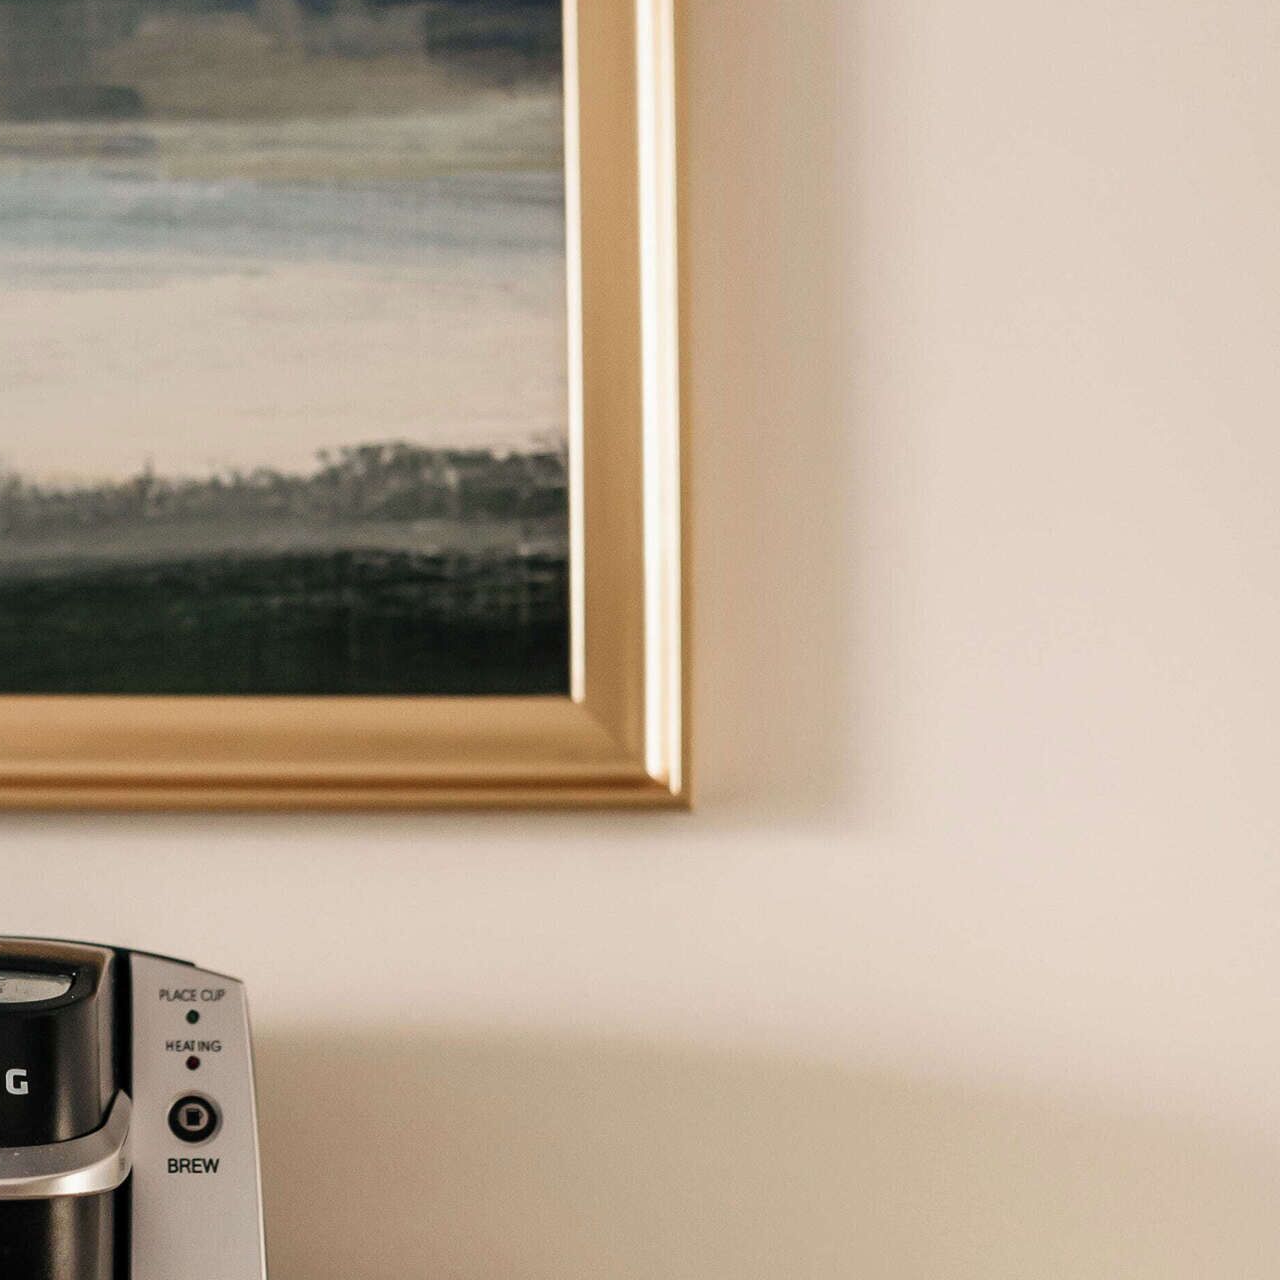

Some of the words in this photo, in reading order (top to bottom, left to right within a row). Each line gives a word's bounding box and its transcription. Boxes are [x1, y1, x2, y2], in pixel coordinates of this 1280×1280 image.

[159, 989, 197, 1001] PLACE
[201, 989, 225, 1001] CUP
[165, 1040, 222, 1052] HEATING
[167, 1158, 220, 1174] BREW
